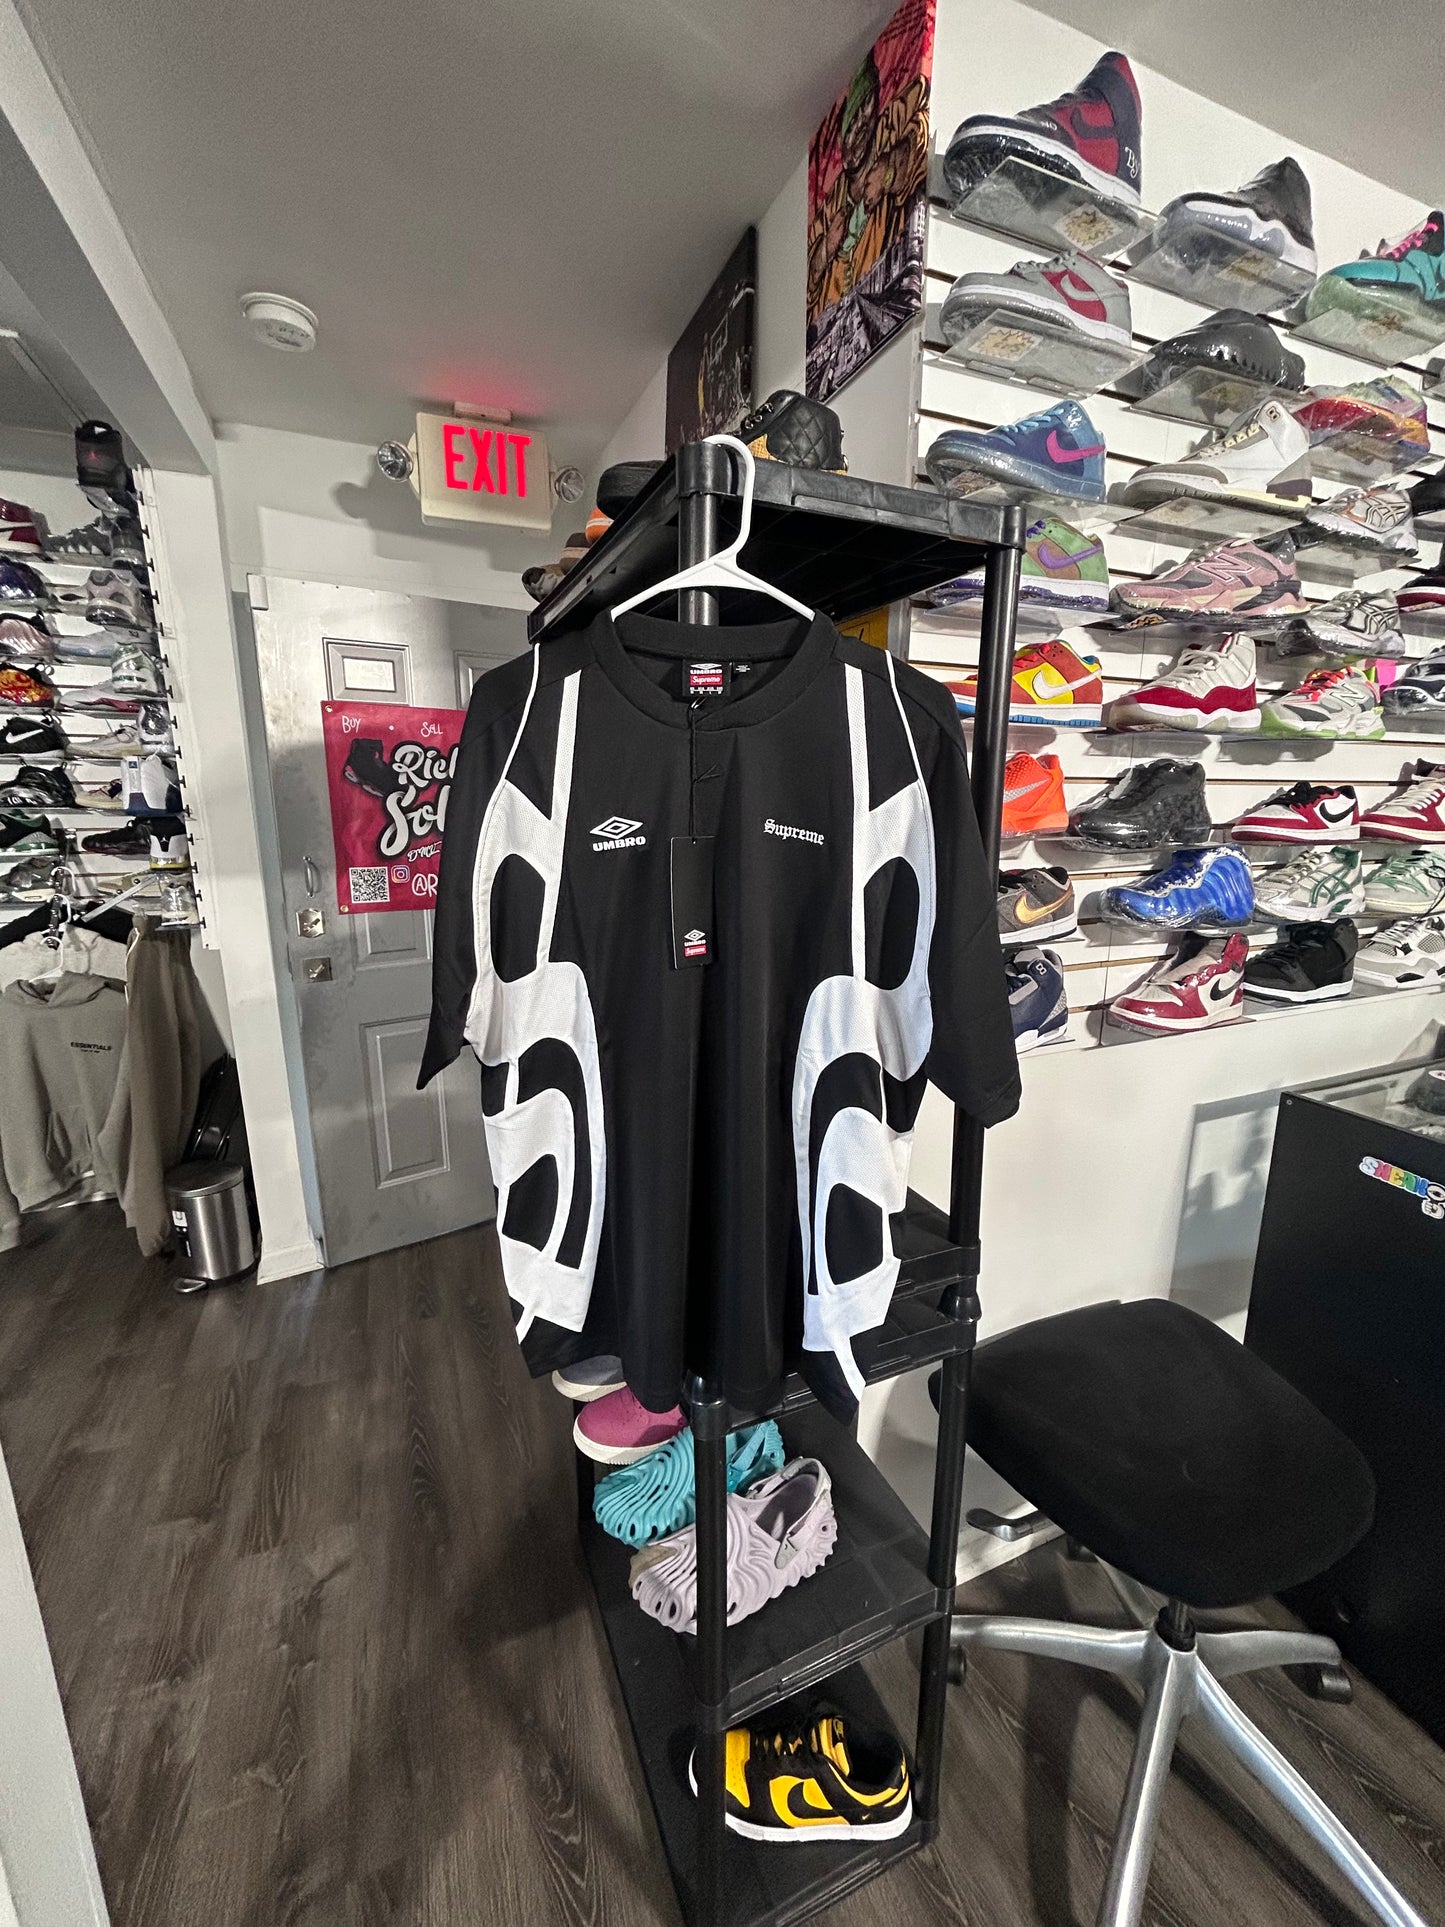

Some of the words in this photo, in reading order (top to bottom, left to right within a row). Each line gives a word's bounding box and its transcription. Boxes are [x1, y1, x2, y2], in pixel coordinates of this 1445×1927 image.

[442, 423, 532, 498] EXIT
[692, 675, 721, 685] Supreme
[763, 818, 825, 846] Supreme
[592, 835, 647, 852] UMBRO
[70, 1041, 112, 1052] ESSENTIALS
